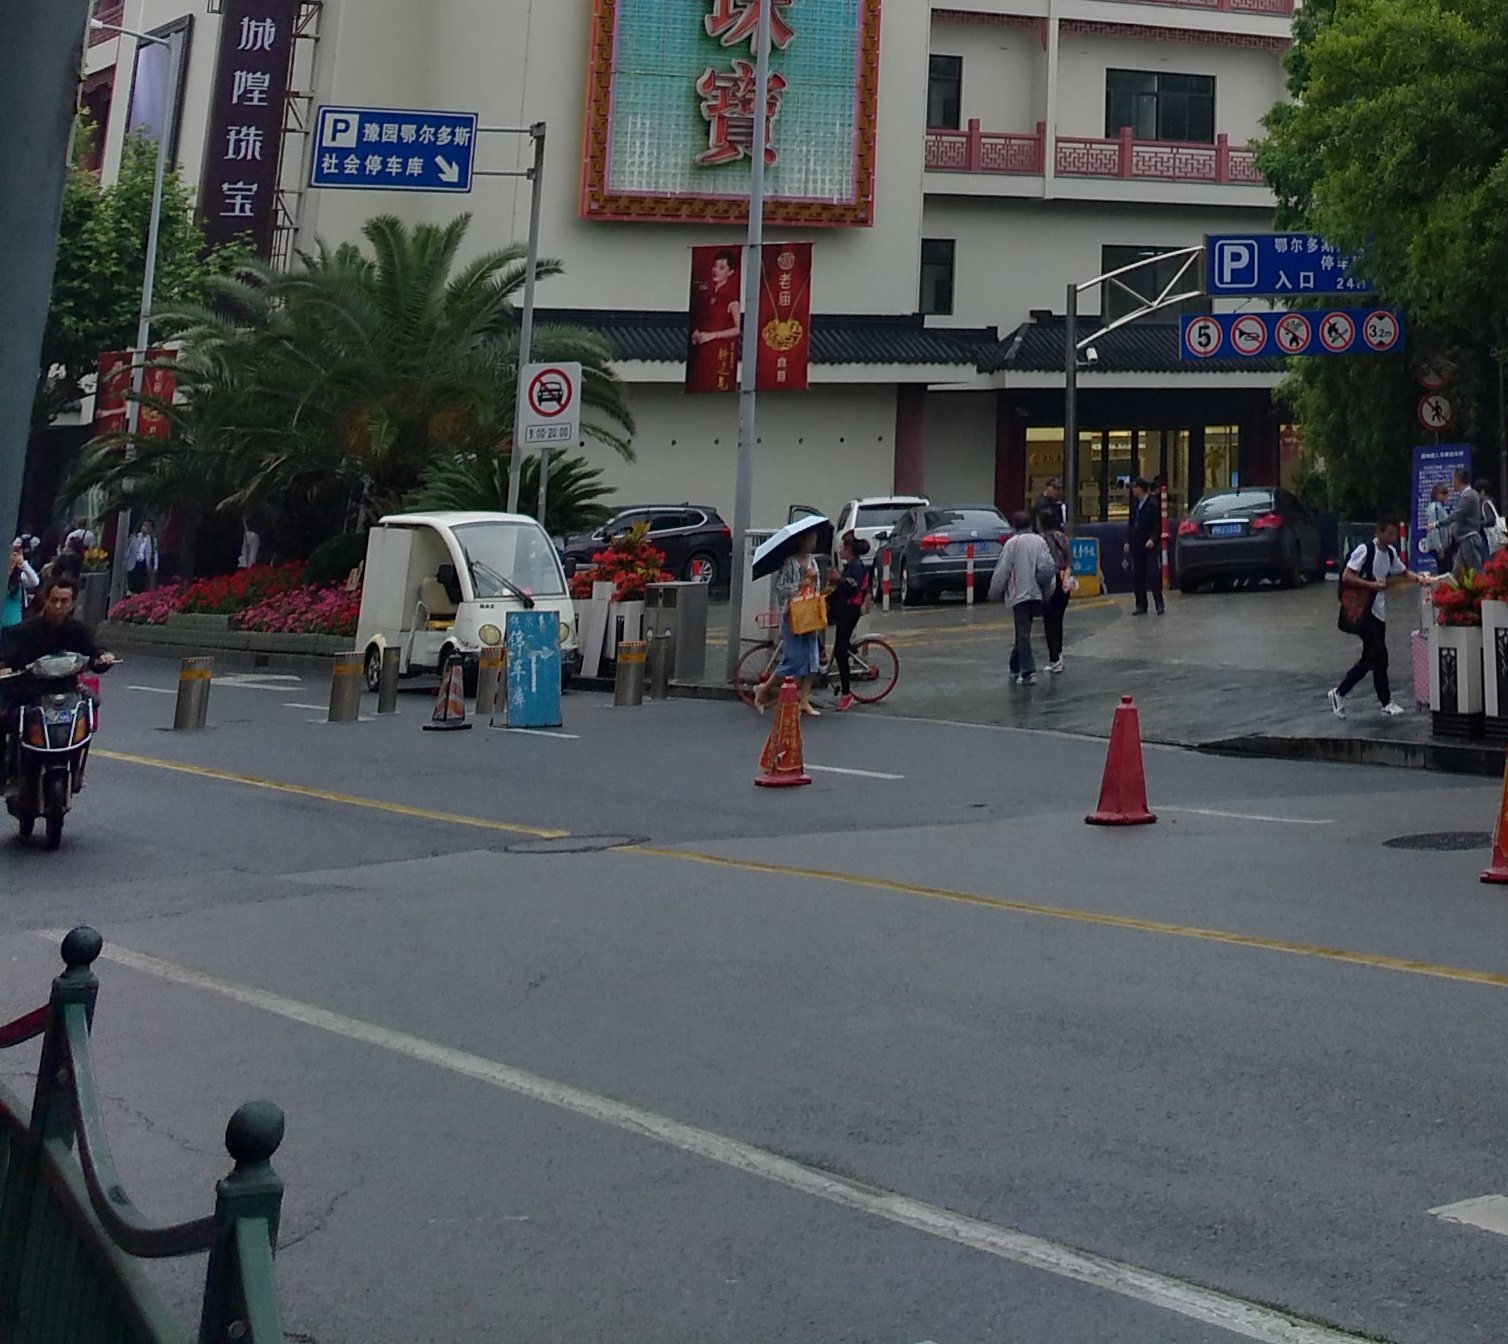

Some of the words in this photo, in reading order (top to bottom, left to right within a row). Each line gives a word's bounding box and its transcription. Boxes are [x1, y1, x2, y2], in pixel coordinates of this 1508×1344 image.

[219, 15, 276, 216] 城隍珠宝
[331, 118, 351, 142] P
[362, 122, 471, 147] 豫园鄂尔多斯
[321, 153, 424, 178] 社会停车库
[1223, 245, 1250, 283] P
[1275, 270, 1315, 290] 入口
[1197, 324, 1212, 348] 5
[1369, 324, 1392, 338] 3.2m
